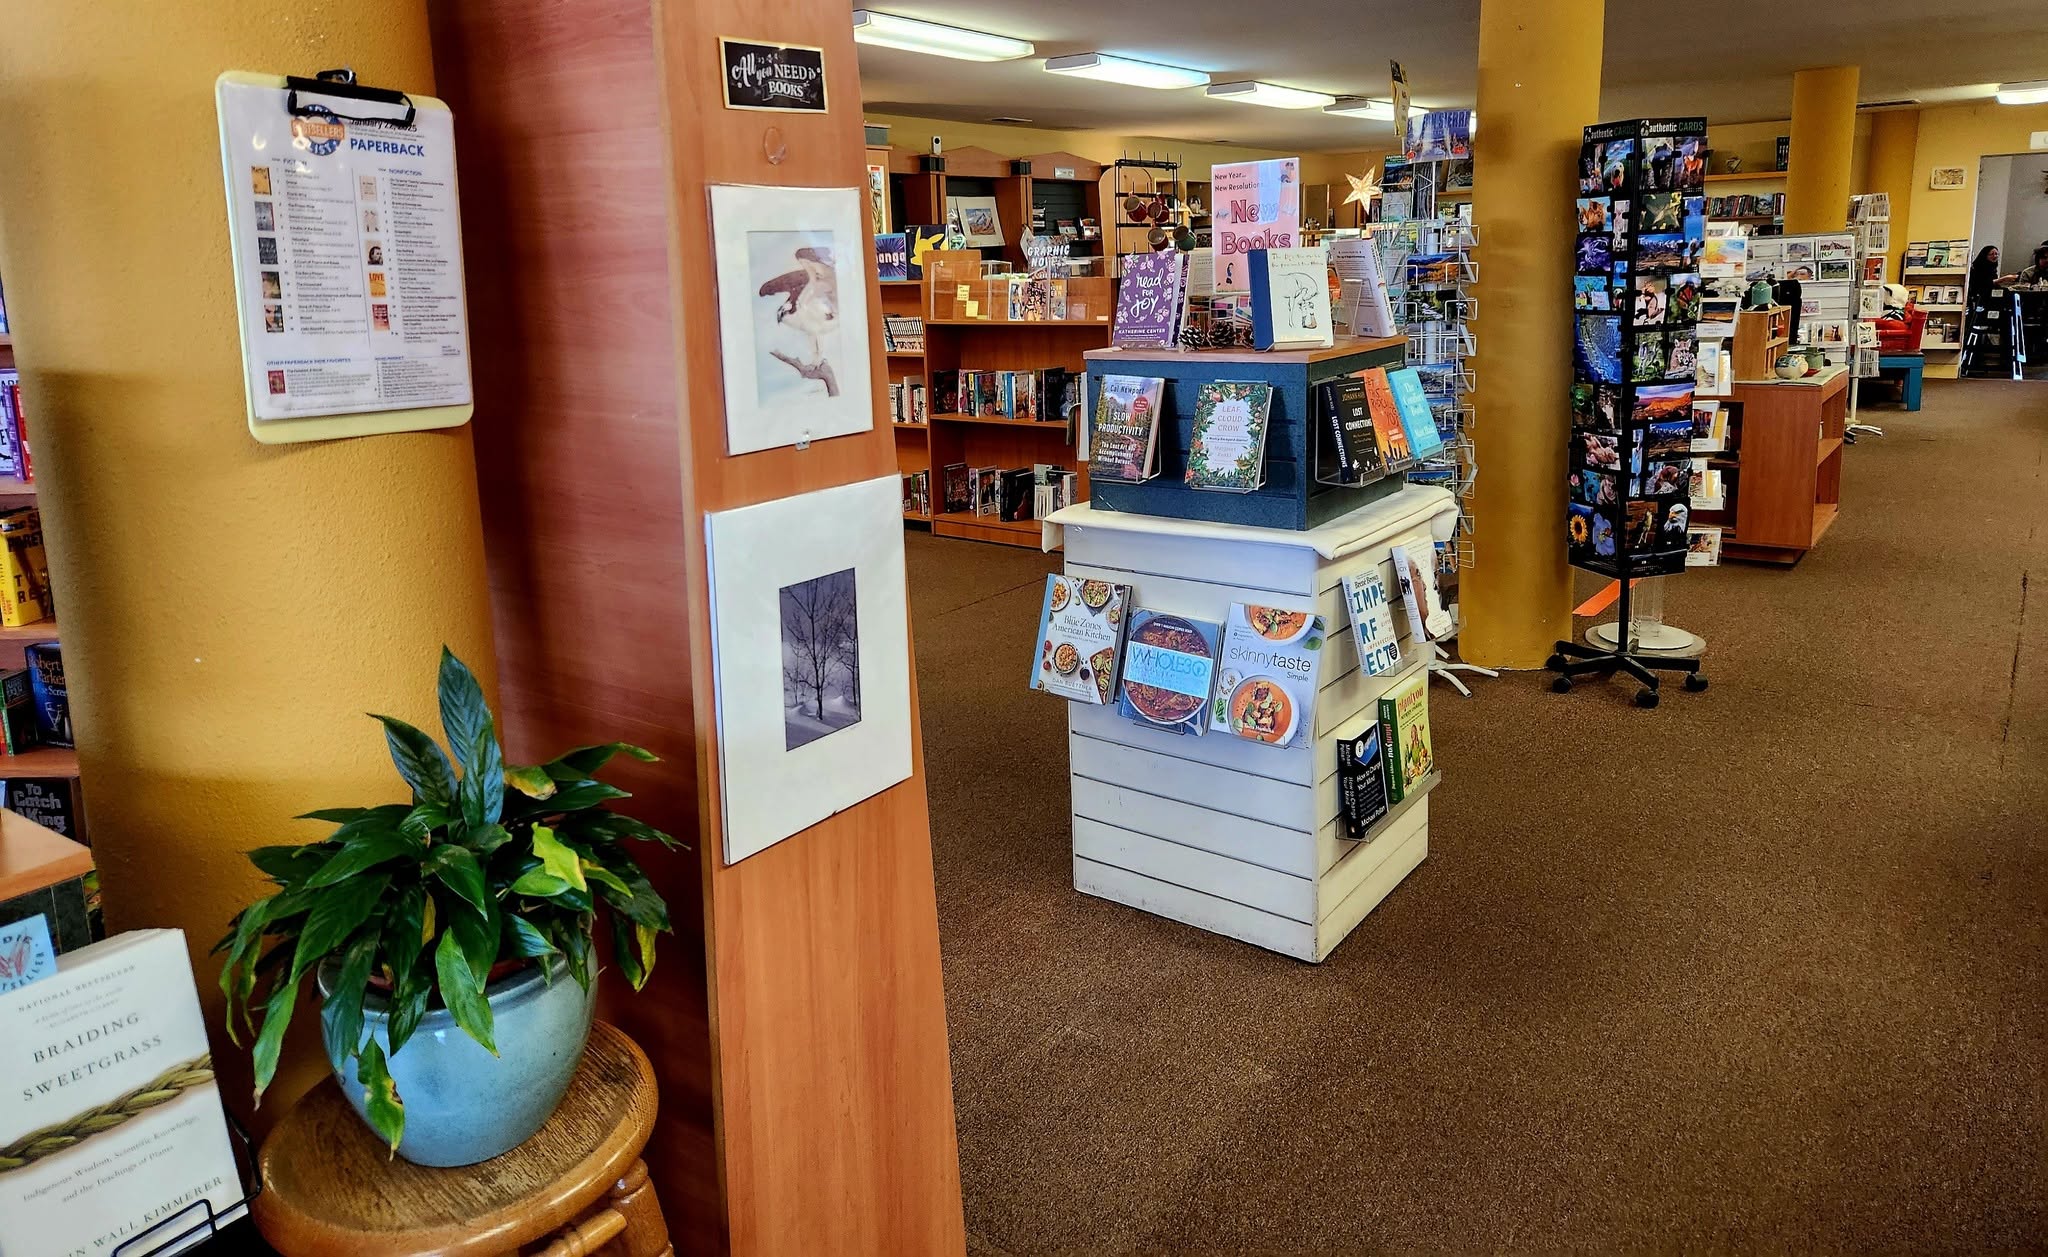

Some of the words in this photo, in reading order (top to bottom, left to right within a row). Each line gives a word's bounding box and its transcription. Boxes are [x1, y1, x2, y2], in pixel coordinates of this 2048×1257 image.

[732, 52, 755, 87] All
[756, 66, 772, 86] you
[774, 64, 807, 80] NEED
[768, 81, 804, 97] BOOKS
[293, 121, 344, 139] BSTSELLERS
[1649, 122, 1678, 133] authentic
[1678, 121, 1704, 132] CARDS
[350, 138, 425, 157] PAPERBACK
[1230, 199, 1278, 224] New
[1026, 245, 1070, 257] GRAPHIC
[1220, 228, 1292, 256] Books
[876, 251, 906, 266] anga
[1136, 267, 1164, 288] read
[1113, 412, 1131, 422] SLOW
[1352, 408, 1364, 416] LOST
[1098, 423, 1143, 436] PRODUCTIVITY
[1218, 424, 1240, 432] CROW
[1345, 418, 1372, 431] CONNECTIONS
[1334, 430, 1348, 468] CONNECTIONS
[1354, 582, 1386, 614] IMPE
[1064, 615, 1080, 624] Blue
[1080, 618, 1102, 630] Zones
[1360, 618, 1378, 644] RF
[1052, 624, 1084, 636] American
[1085, 628, 1110, 641] Kitchen
[28, 654, 62, 672] Robert
[1132, 646, 1206, 677] WHOLE30
[1230, 646, 1312, 672] skinnytaste
[1366, 644, 1392, 676] ECT
[36, 670, 66, 686] Parker
[1286, 671, 1308, 682] Simple
[48, 685, 68, 698] Scree
[1356, 772, 1365, 782] How
[1357, 782, 1366, 792] Your
[1366, 776, 1375, 787] Mind
[13, 790, 62, 810] Catch
[26, 808, 67, 834] King
[1360, 813, 1375, 827] Michael
[1375, 806, 1385, 818] Pollan
[18, 989, 71, 1012] NATIONAL
[33, 1012, 140, 1064] BRAIDING
[24, 1034, 162, 1102] SWEETGRASS
[23, 1175, 73, 1202] Indigenous
[75, 1156, 114, 1178] Wisdom,
[114, 1137, 152, 1160] Scientific
[62, 1190, 78, 1203] and
[80, 1183, 94, 1196] the
[97, 1163, 138, 1186] Teachings
[149, 1144, 174, 1160] Plants
[93, 1221, 139, 1248] WALL
[144, 1176, 223, 1223] KIMMERER
